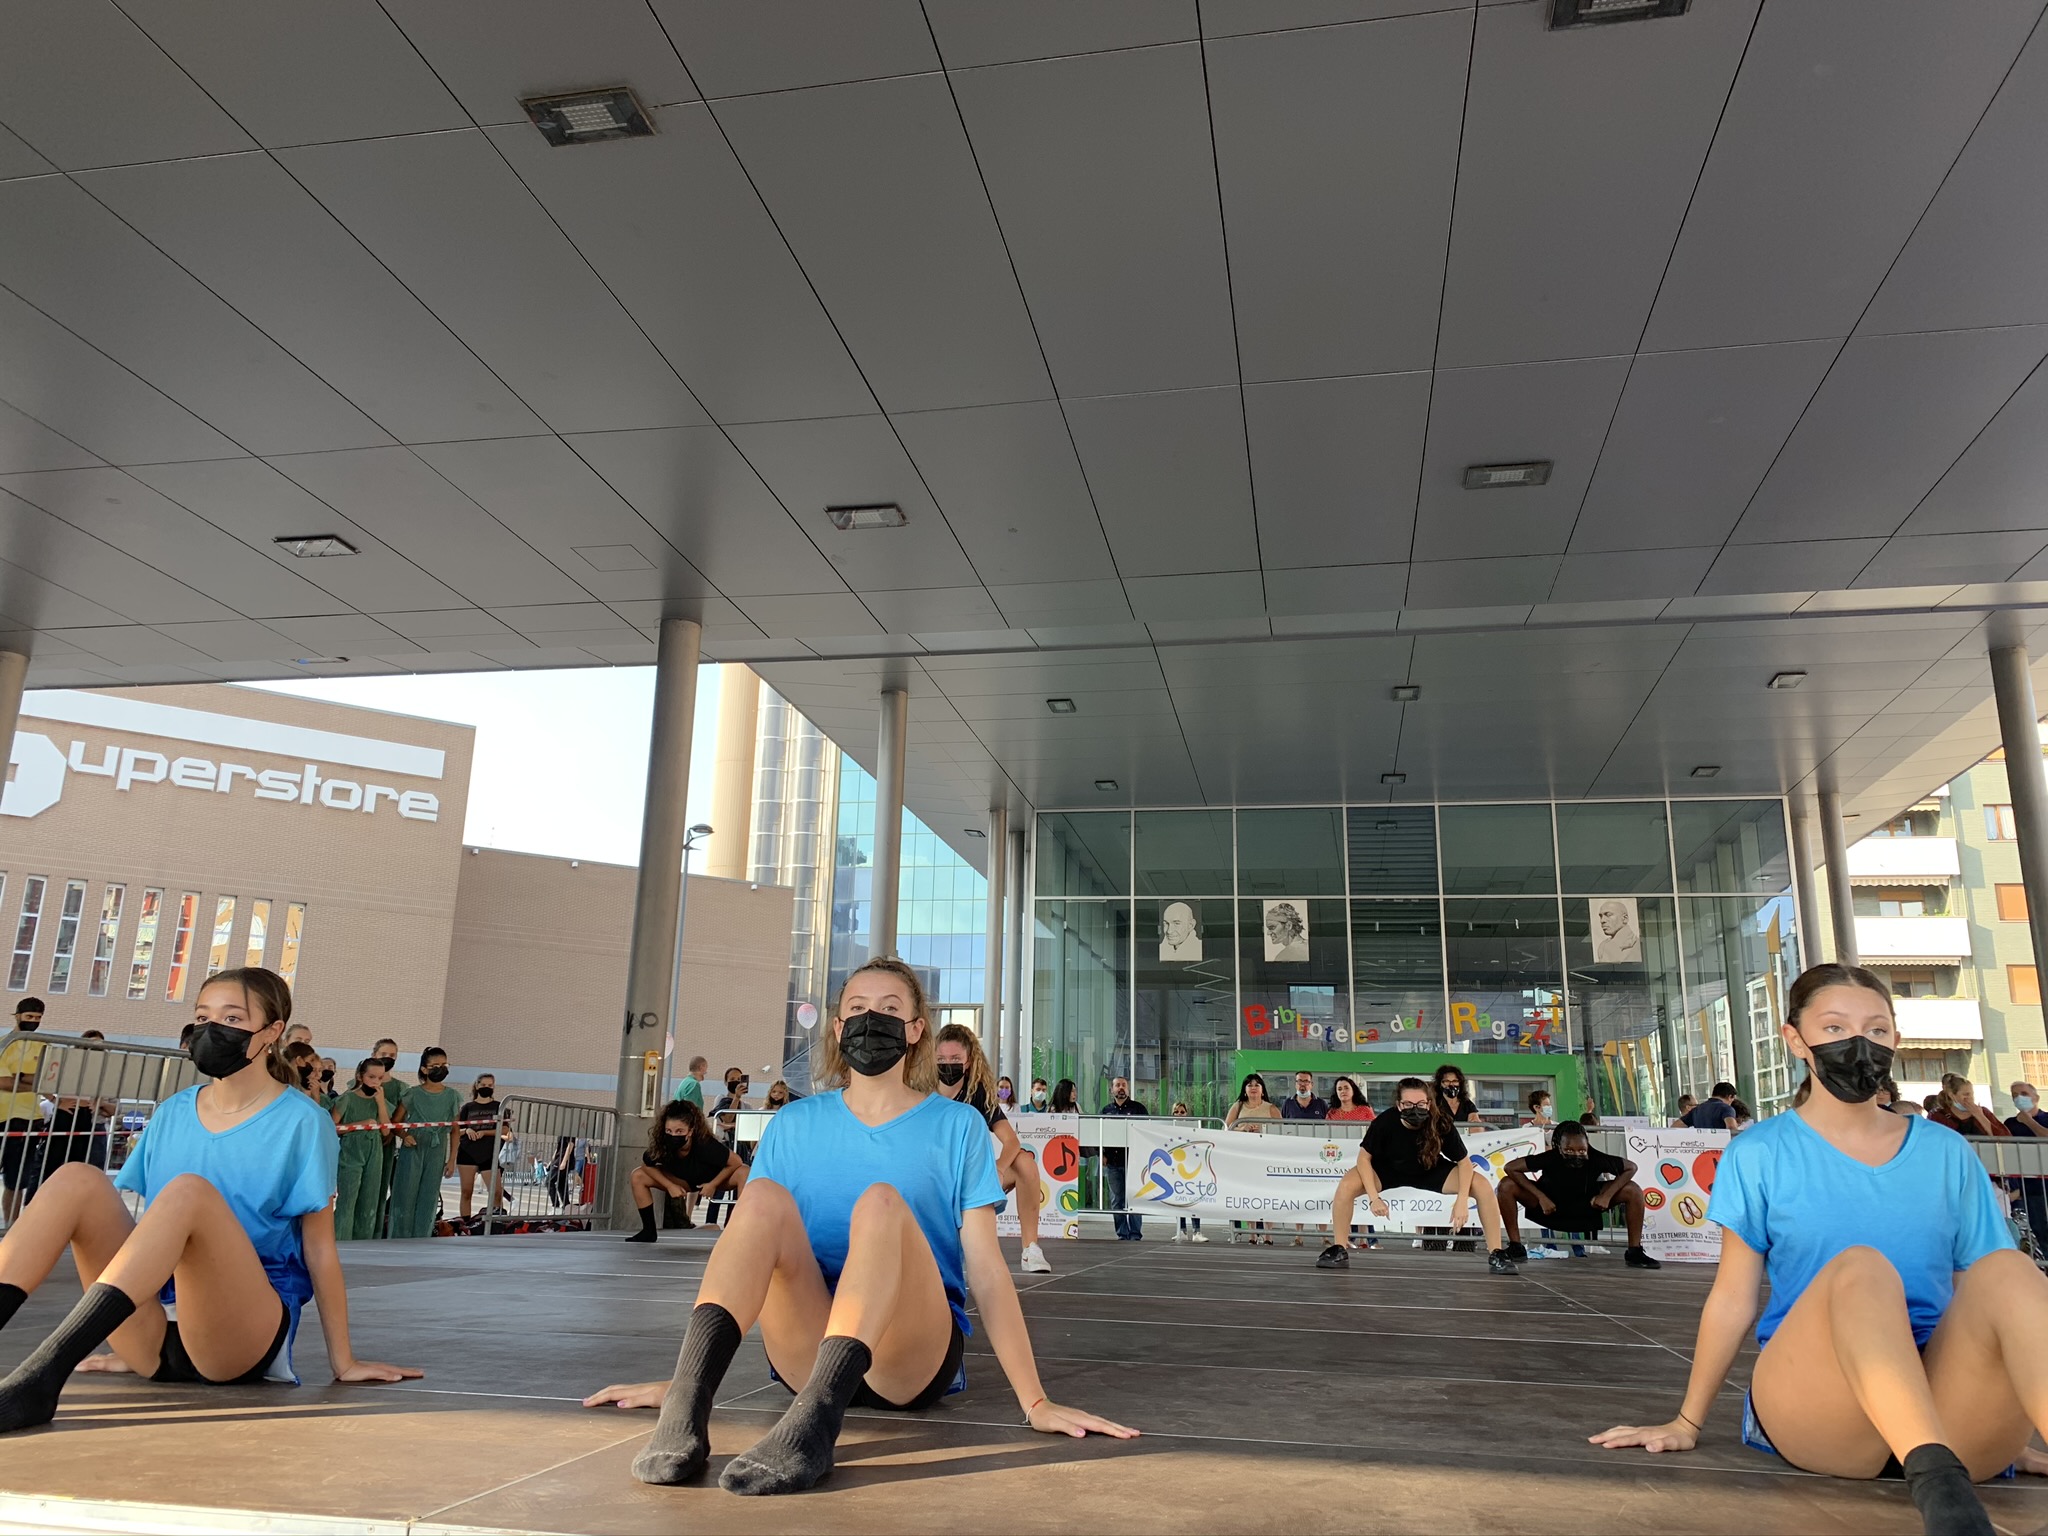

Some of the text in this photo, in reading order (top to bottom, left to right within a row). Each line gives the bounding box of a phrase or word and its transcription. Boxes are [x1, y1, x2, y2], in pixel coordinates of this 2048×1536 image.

[1243, 996, 1564, 1047] Biblioteca dei Ragazzi
[1225, 1196, 1300, 1211] EUROPEAN
[1304, 1199, 1333, 1211] CITY
[1409, 1199, 1443, 1212] 2022
